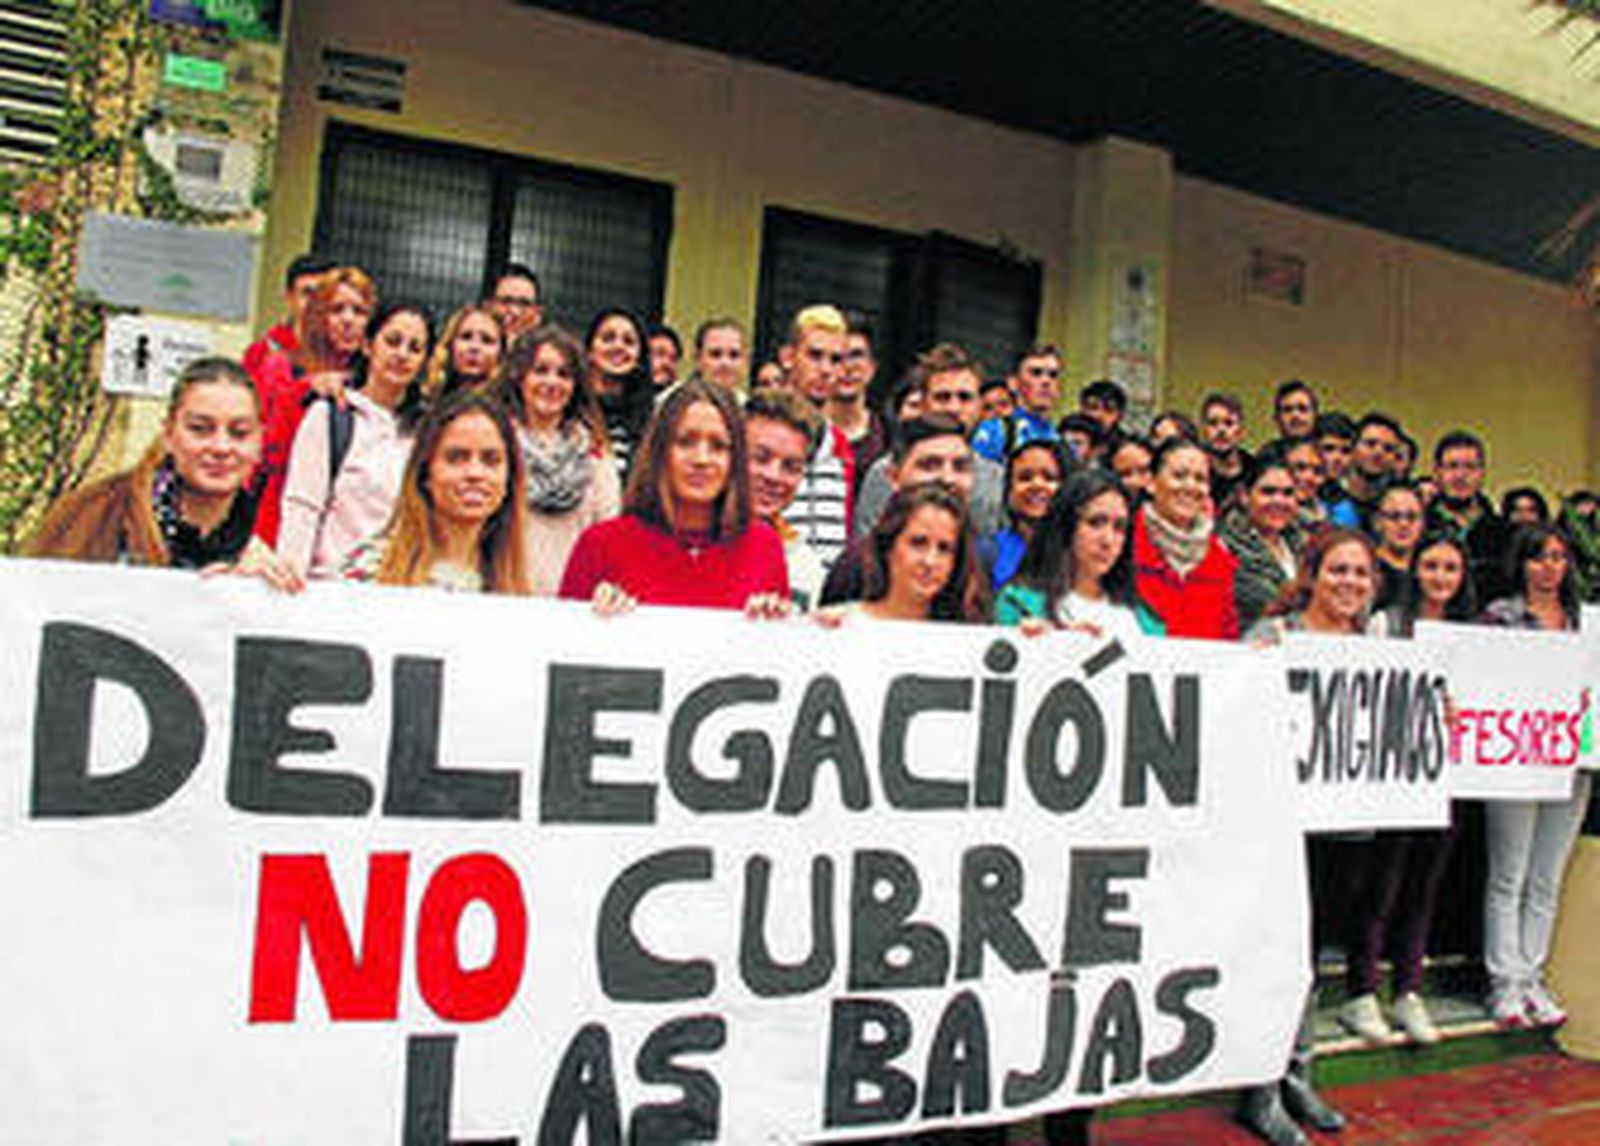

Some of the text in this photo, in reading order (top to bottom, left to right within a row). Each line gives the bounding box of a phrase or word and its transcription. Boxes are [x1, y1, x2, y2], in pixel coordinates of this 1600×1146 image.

[29, 620, 1201, 825] DELEGACIÓN
[1445, 706, 1582, 766] FESORES
[248, 843, 1151, 1024] NO CUBRE
[402, 966, 1221, 1146] LAS BAJAS
